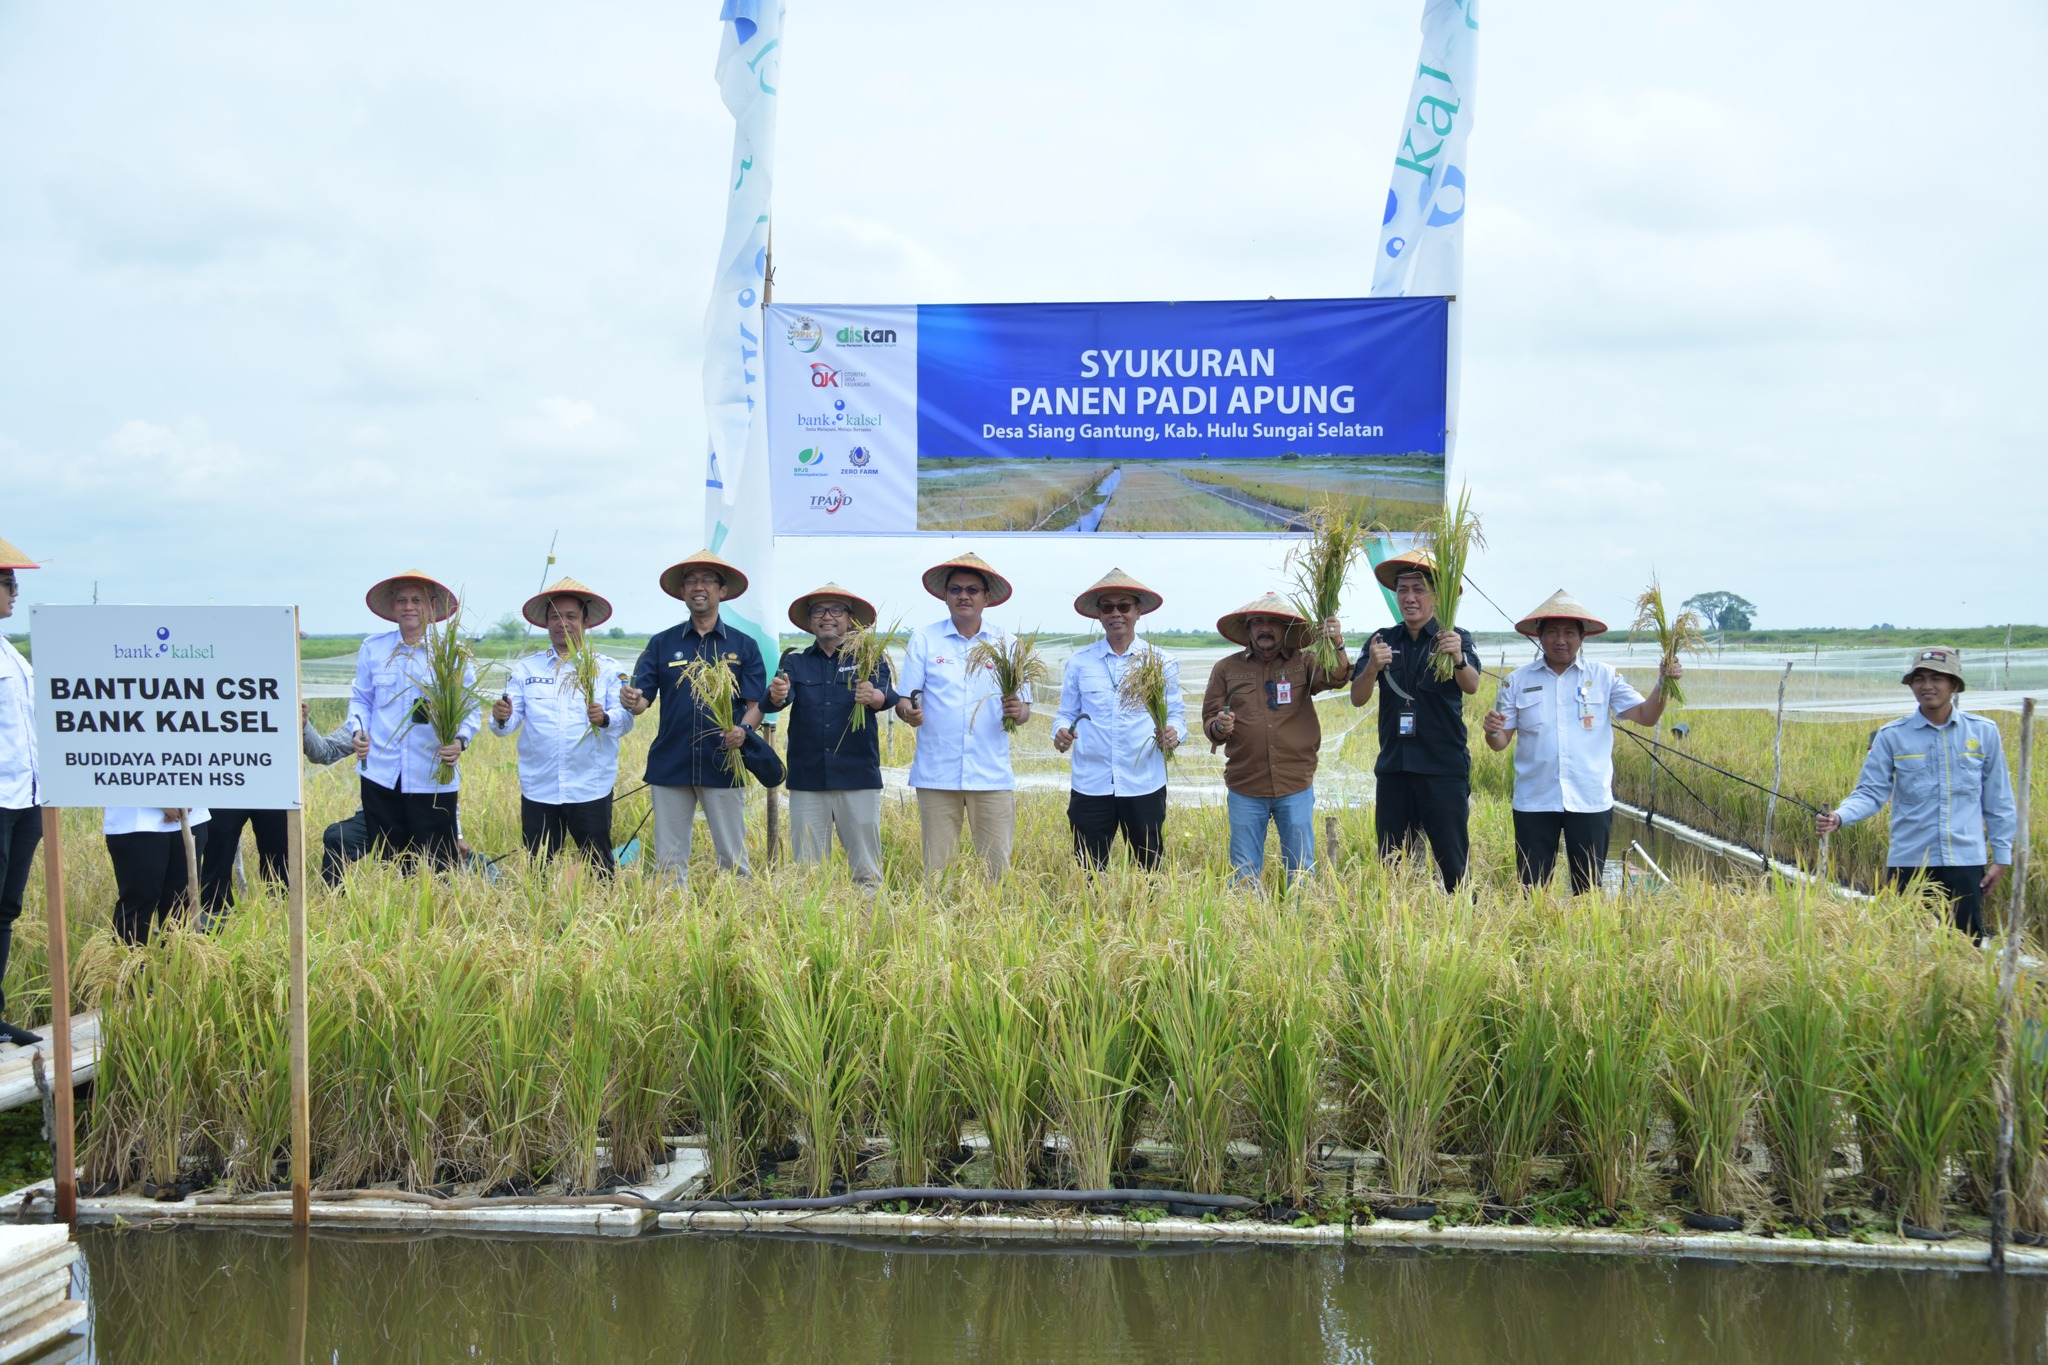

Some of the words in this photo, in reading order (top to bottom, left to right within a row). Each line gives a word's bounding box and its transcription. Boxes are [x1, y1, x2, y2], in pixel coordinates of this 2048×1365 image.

[836, 326, 897, 343] distan
[1080, 348, 1274, 378] SYUKURAN
[1011, 386, 1126, 416] PANEN
[1137, 386, 1216, 415] PADI
[1227, 385, 1355, 414] APUNG
[798, 413, 830, 426] bank
[846, 413, 882, 426] kalsel
[983, 423, 1023, 439] Desa
[1028, 422, 1076, 442] Siang
[1080, 422, 1160, 442] Gantung,
[1165, 422, 1203, 438] Kab.
[1208, 422, 1248, 438] Hulu
[1253, 422, 1313, 442] Sungai
[1318, 422, 1384, 438] Selatan
[114, 644, 153, 659] bank
[171, 644, 215, 659] kalsel
[50, 677, 205, 700] BANTUAN
[216, 677, 280, 700] CSR
[55, 710, 146, 733] BANK
[156, 710, 279, 733] KALSEL
[65, 752, 156, 766] BUDIDAYA
[162, 752, 202, 766] PADI
[208, 752, 272, 766] APUNG
[94, 772, 203, 786] KABUPATEN
[209, 772, 246, 786] HSS
